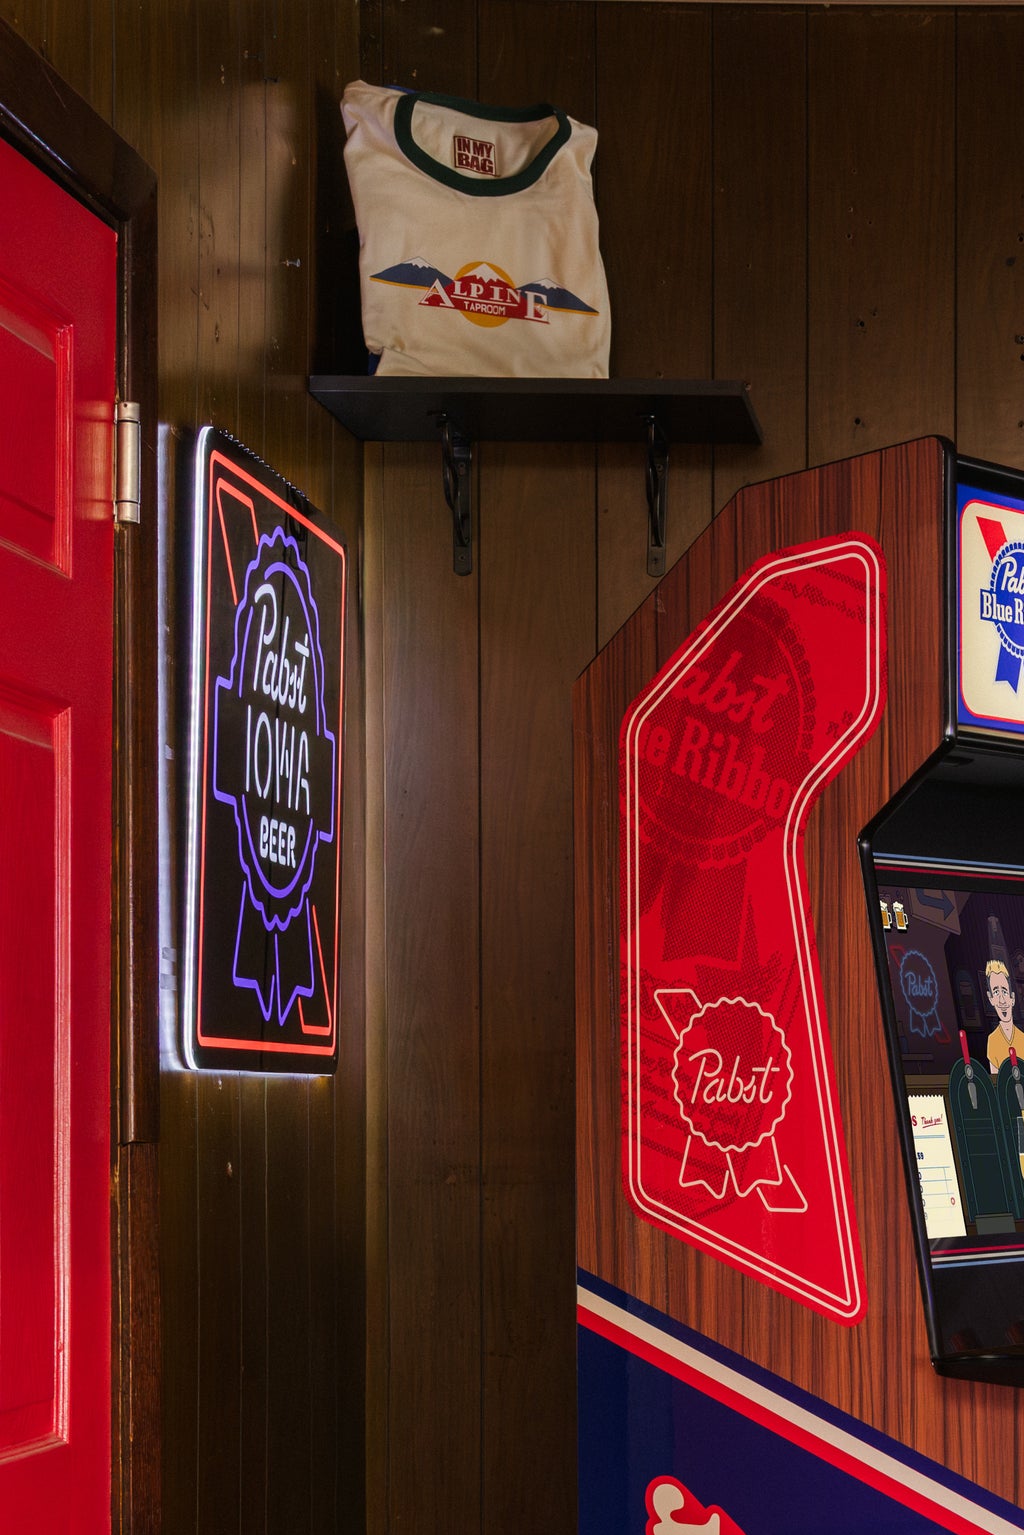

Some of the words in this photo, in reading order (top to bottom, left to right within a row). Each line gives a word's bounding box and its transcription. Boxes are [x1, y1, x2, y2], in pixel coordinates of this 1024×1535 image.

[457, 138, 471, 153] IN
[472, 142, 493, 159] MY
[458, 153, 494, 174] BAG
[420, 278, 550, 322] ALPINE
[464, 301, 506, 316] TAPROOM
[982, 591, 1013, 623] Blue
[253, 583, 310, 714] Pabst
[245, 704, 310, 816] IOWA
[259, 815, 296, 869] BEER
[904, 972, 933, 997] Pabst
[688, 1048, 780, 1104] Pabst
